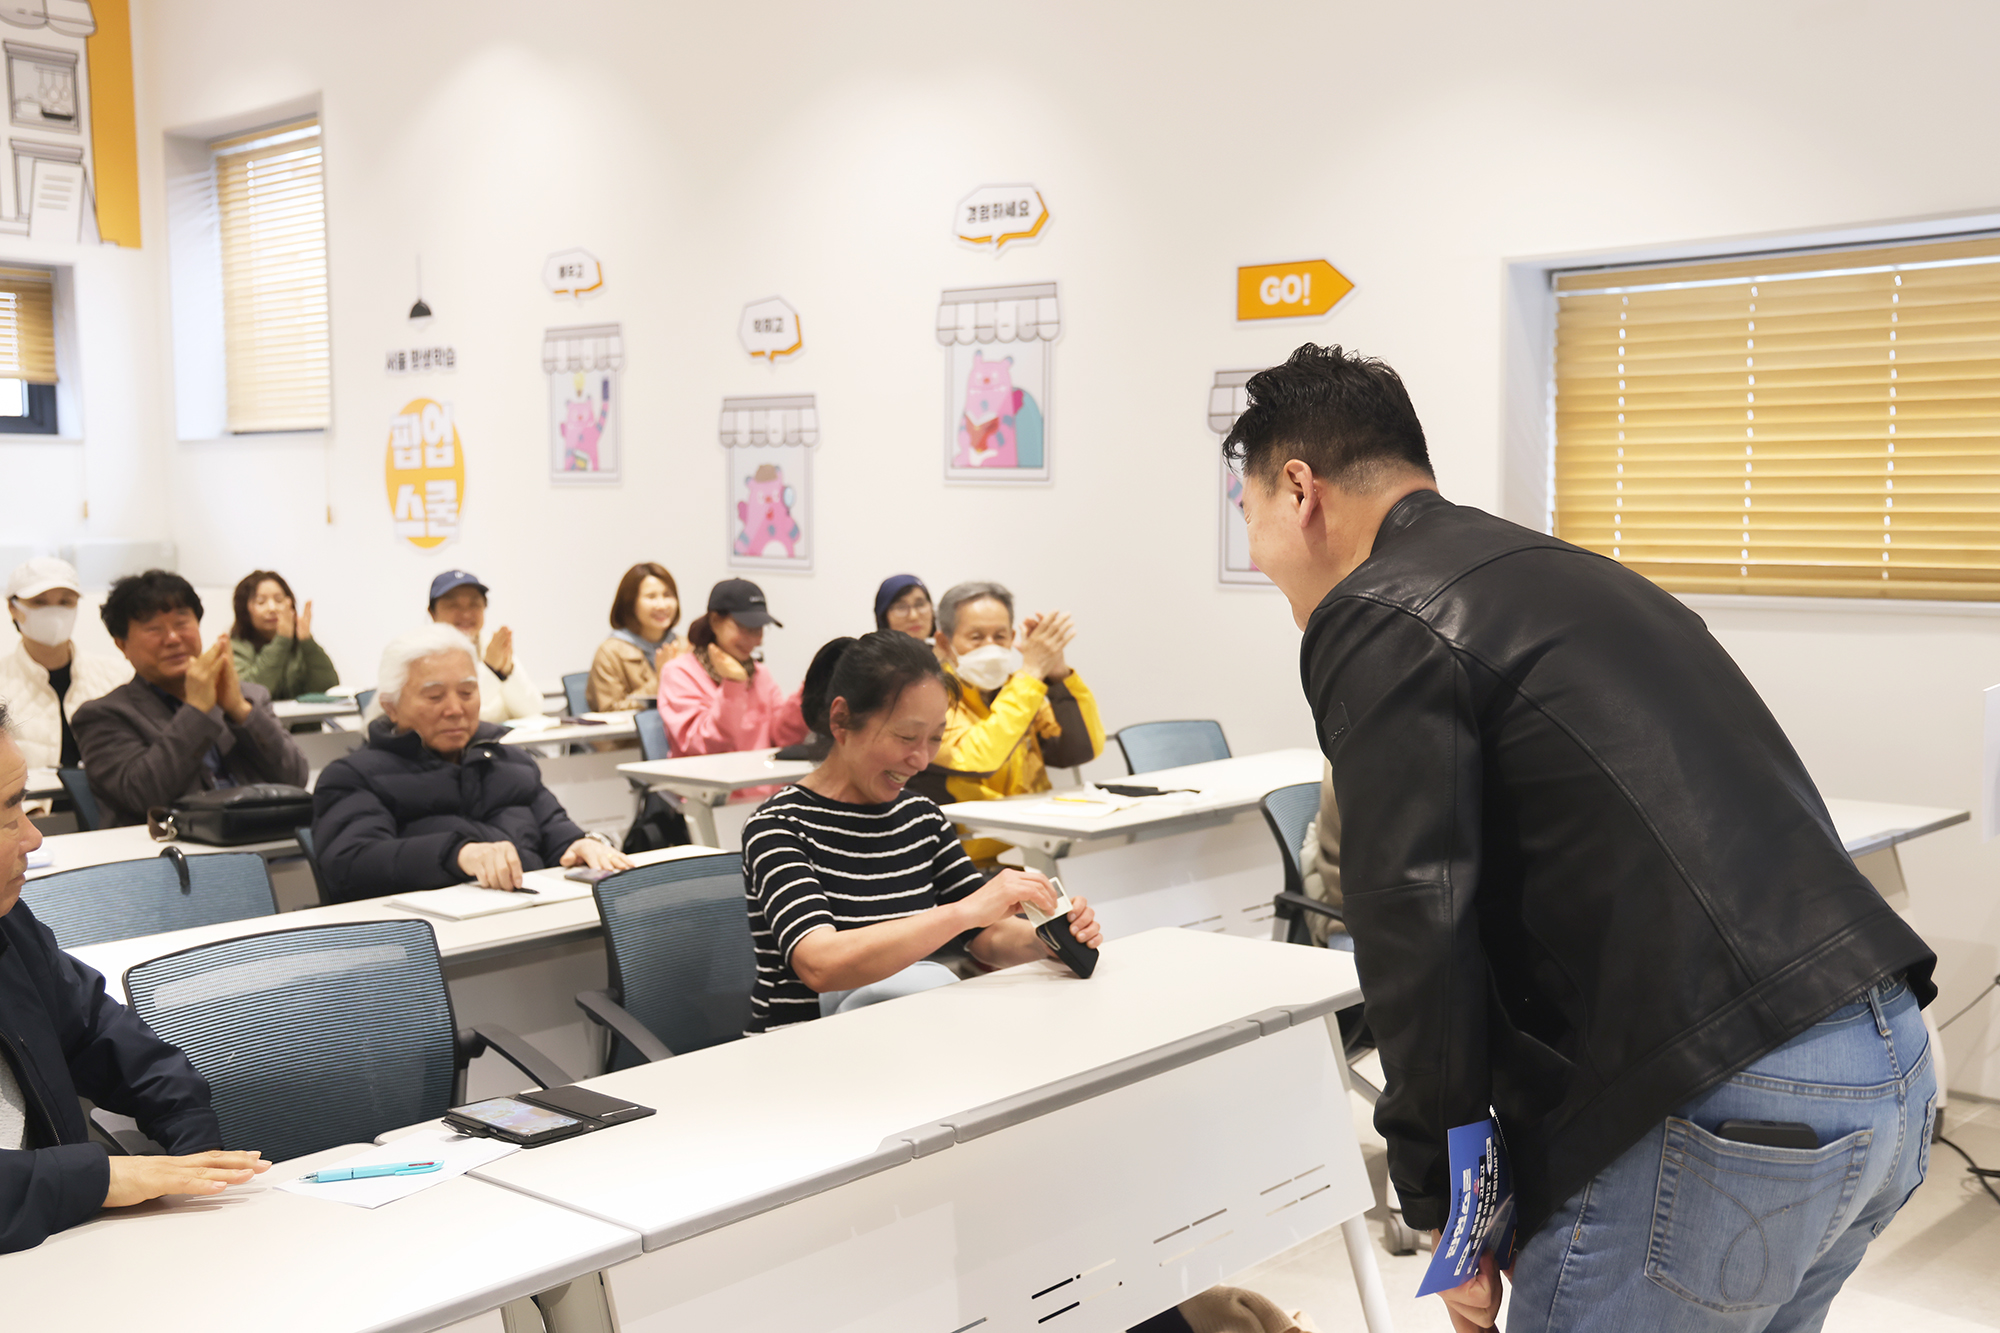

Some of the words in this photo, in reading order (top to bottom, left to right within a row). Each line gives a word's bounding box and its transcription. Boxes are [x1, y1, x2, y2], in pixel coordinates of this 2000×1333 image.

[967, 200, 1029, 223] 경험하세요
[1259, 273, 1311, 306] GO!
[395, 480, 459, 538] 스쿨
